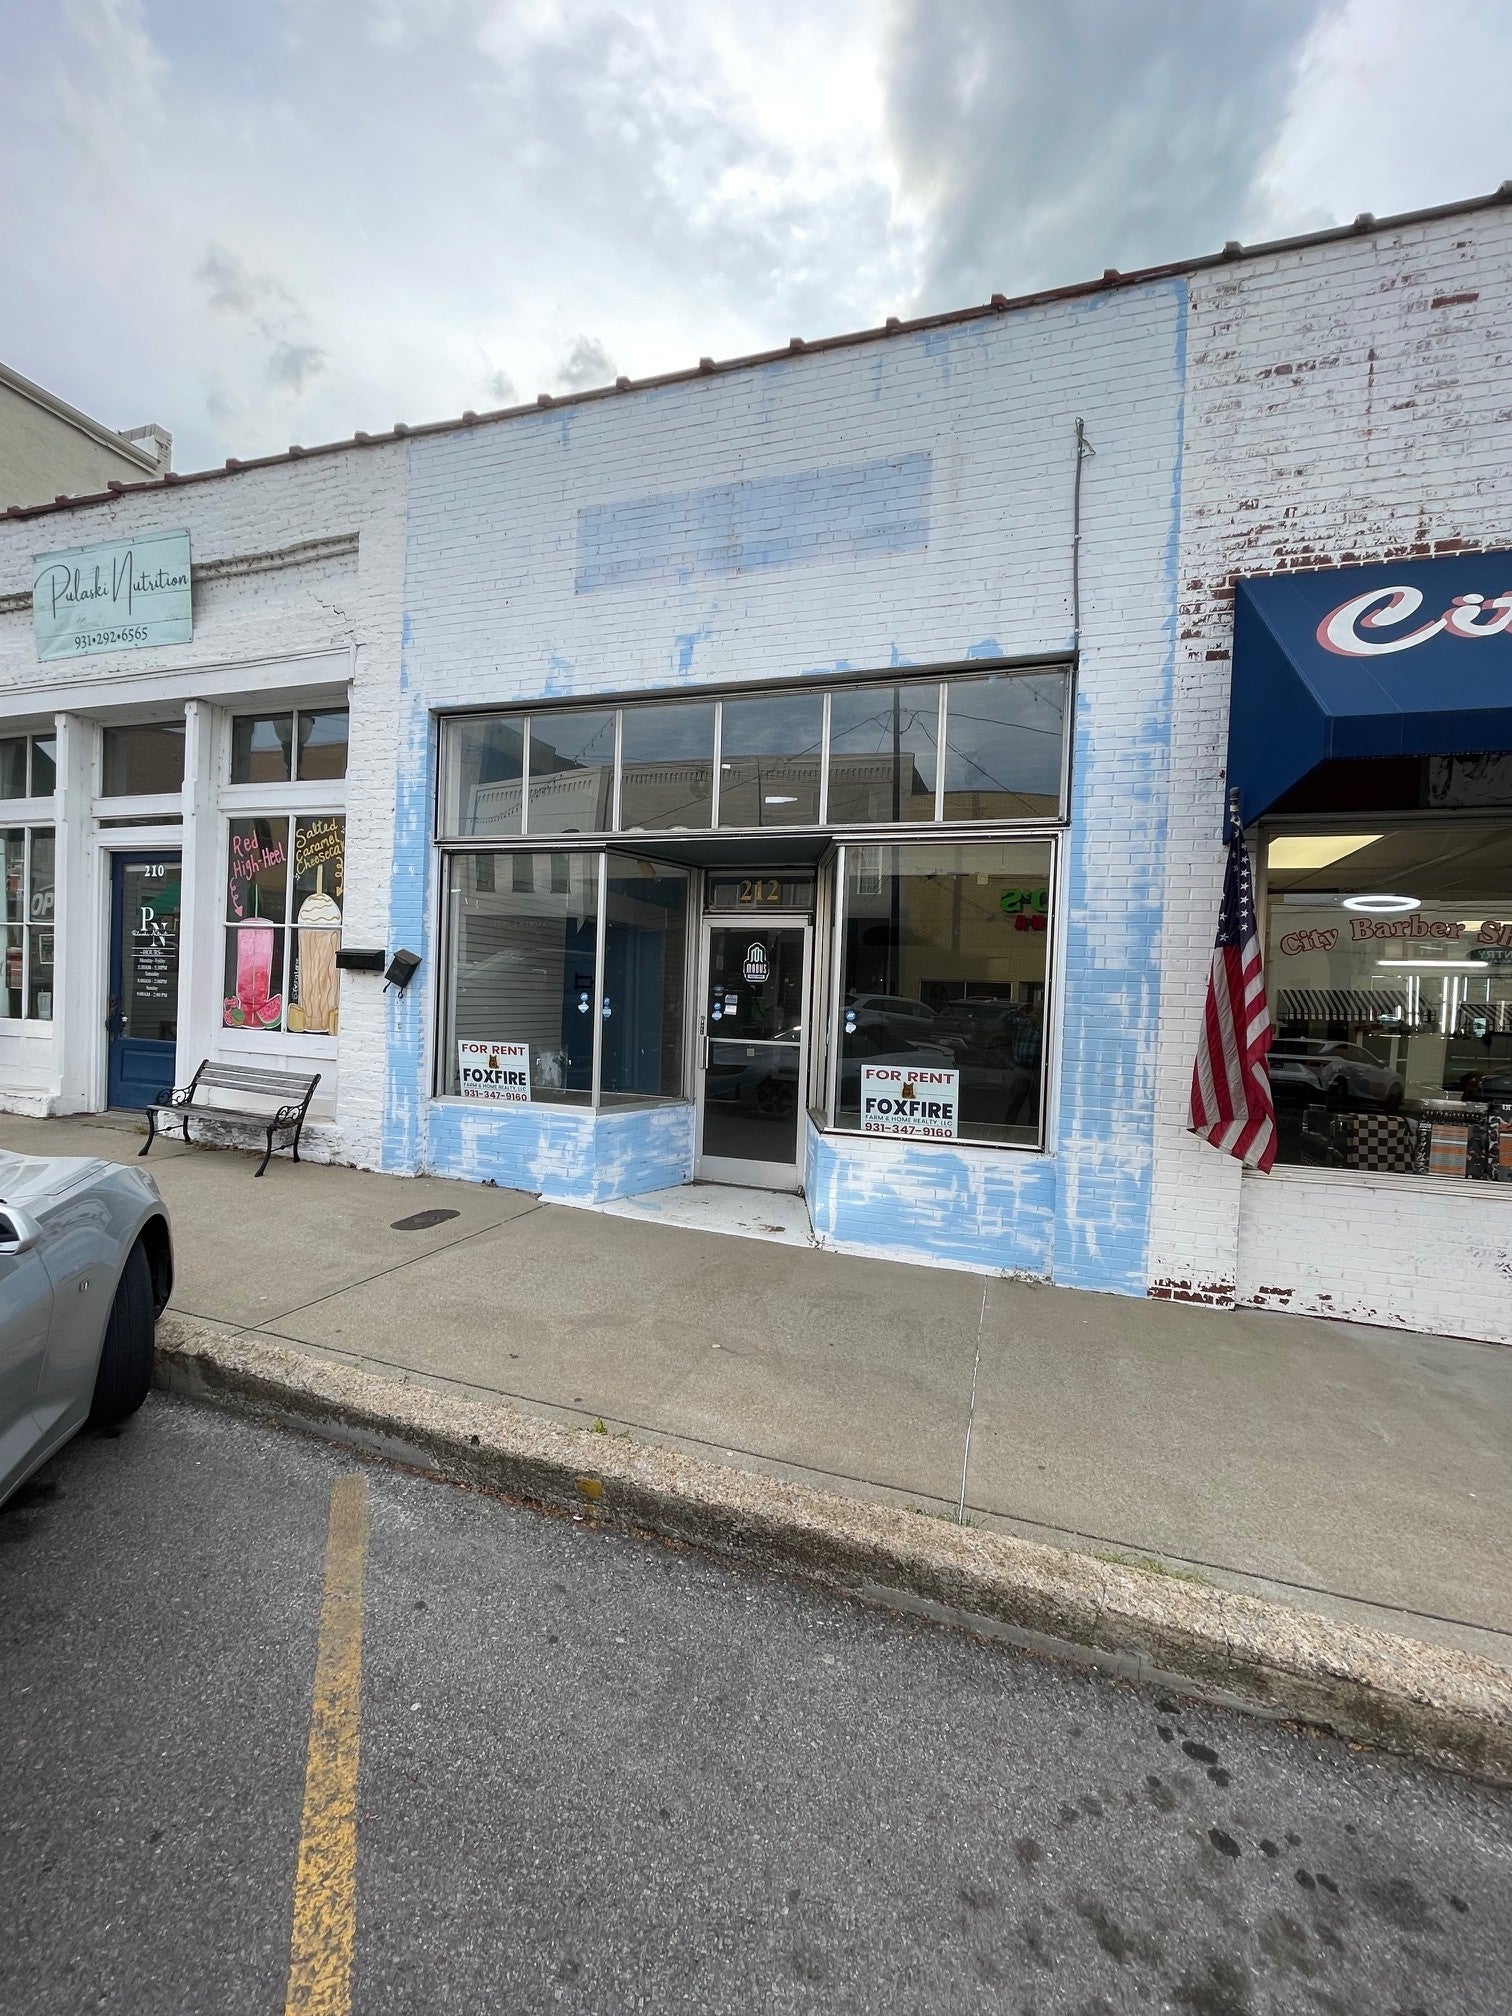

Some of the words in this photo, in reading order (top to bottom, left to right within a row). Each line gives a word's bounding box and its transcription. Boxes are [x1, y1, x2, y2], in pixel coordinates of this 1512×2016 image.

[33, 564, 109, 619] Pulaski
[112, 550, 189, 616] Nutrition
[232, 829, 259, 857] Red
[296, 817, 338, 848] Salted
[144, 864, 164, 877] 210
[233, 842, 287, 881] High-Heel
[740, 879, 779, 901] 212
[1280, 928, 1338, 955] City
[1350, 914, 1466, 941] Barber
[461, 1044, 487, 1053] FOR
[492, 1046, 525, 1055] RENT
[463, 1068, 526, 1085] FOXFIRE
[865, 1069, 901, 1081] FOR
[908, 1071, 954, 1084] RENT
[464, 1089, 527, 1101] 931-347-9160
[866, 1098, 953, 1119] FOXFIRE
[865, 1122, 952, 1137] 931-347-9160
